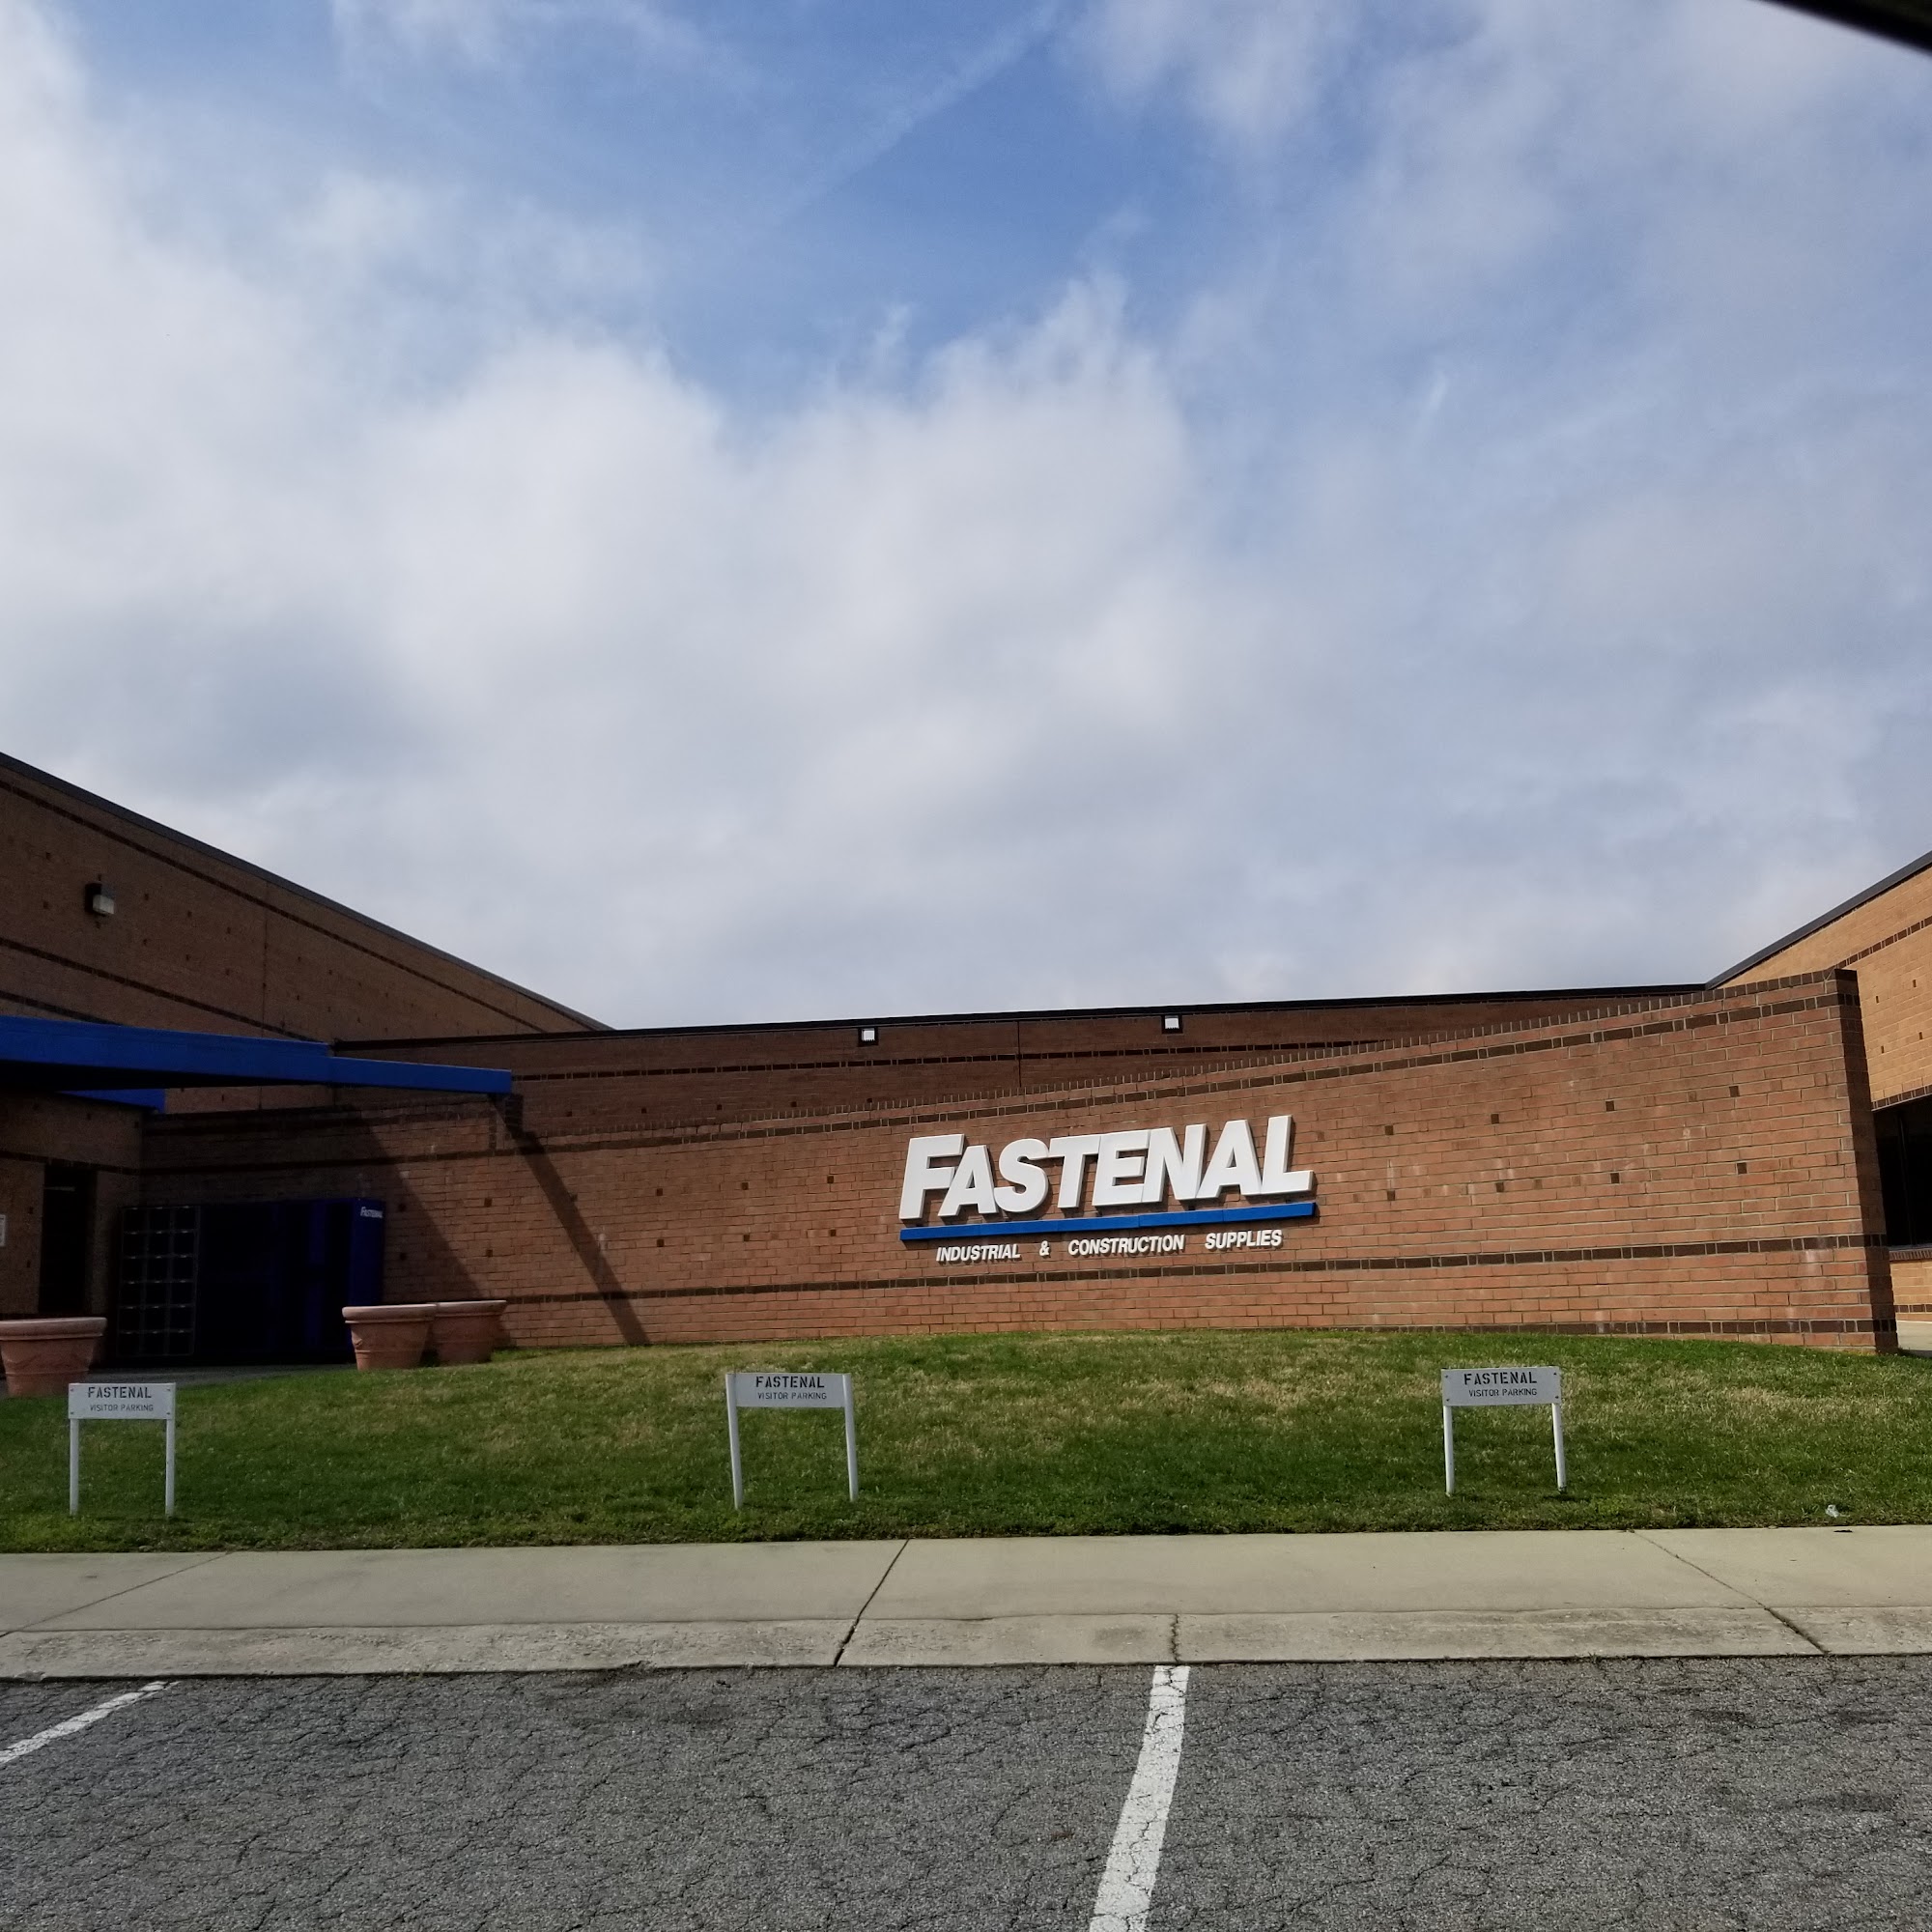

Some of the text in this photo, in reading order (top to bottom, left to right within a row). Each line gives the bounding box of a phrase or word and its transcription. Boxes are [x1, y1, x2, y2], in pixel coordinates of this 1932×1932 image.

[899, 1115, 1314, 1219] FASTENAL
[936, 1229, 1284, 1262] INDUSTRIAL & CONSTRUCTION SUPPLIES
[755, 1376, 825, 1388] FASTENAL
[1463, 1371, 1538, 1385] FASTENAL
[87, 1386, 153, 1399] FASTENAL
[1468, 1387, 1538, 1398] VISITOR PARKING
[90, 1404, 155, 1412] VISITOR PARKING
